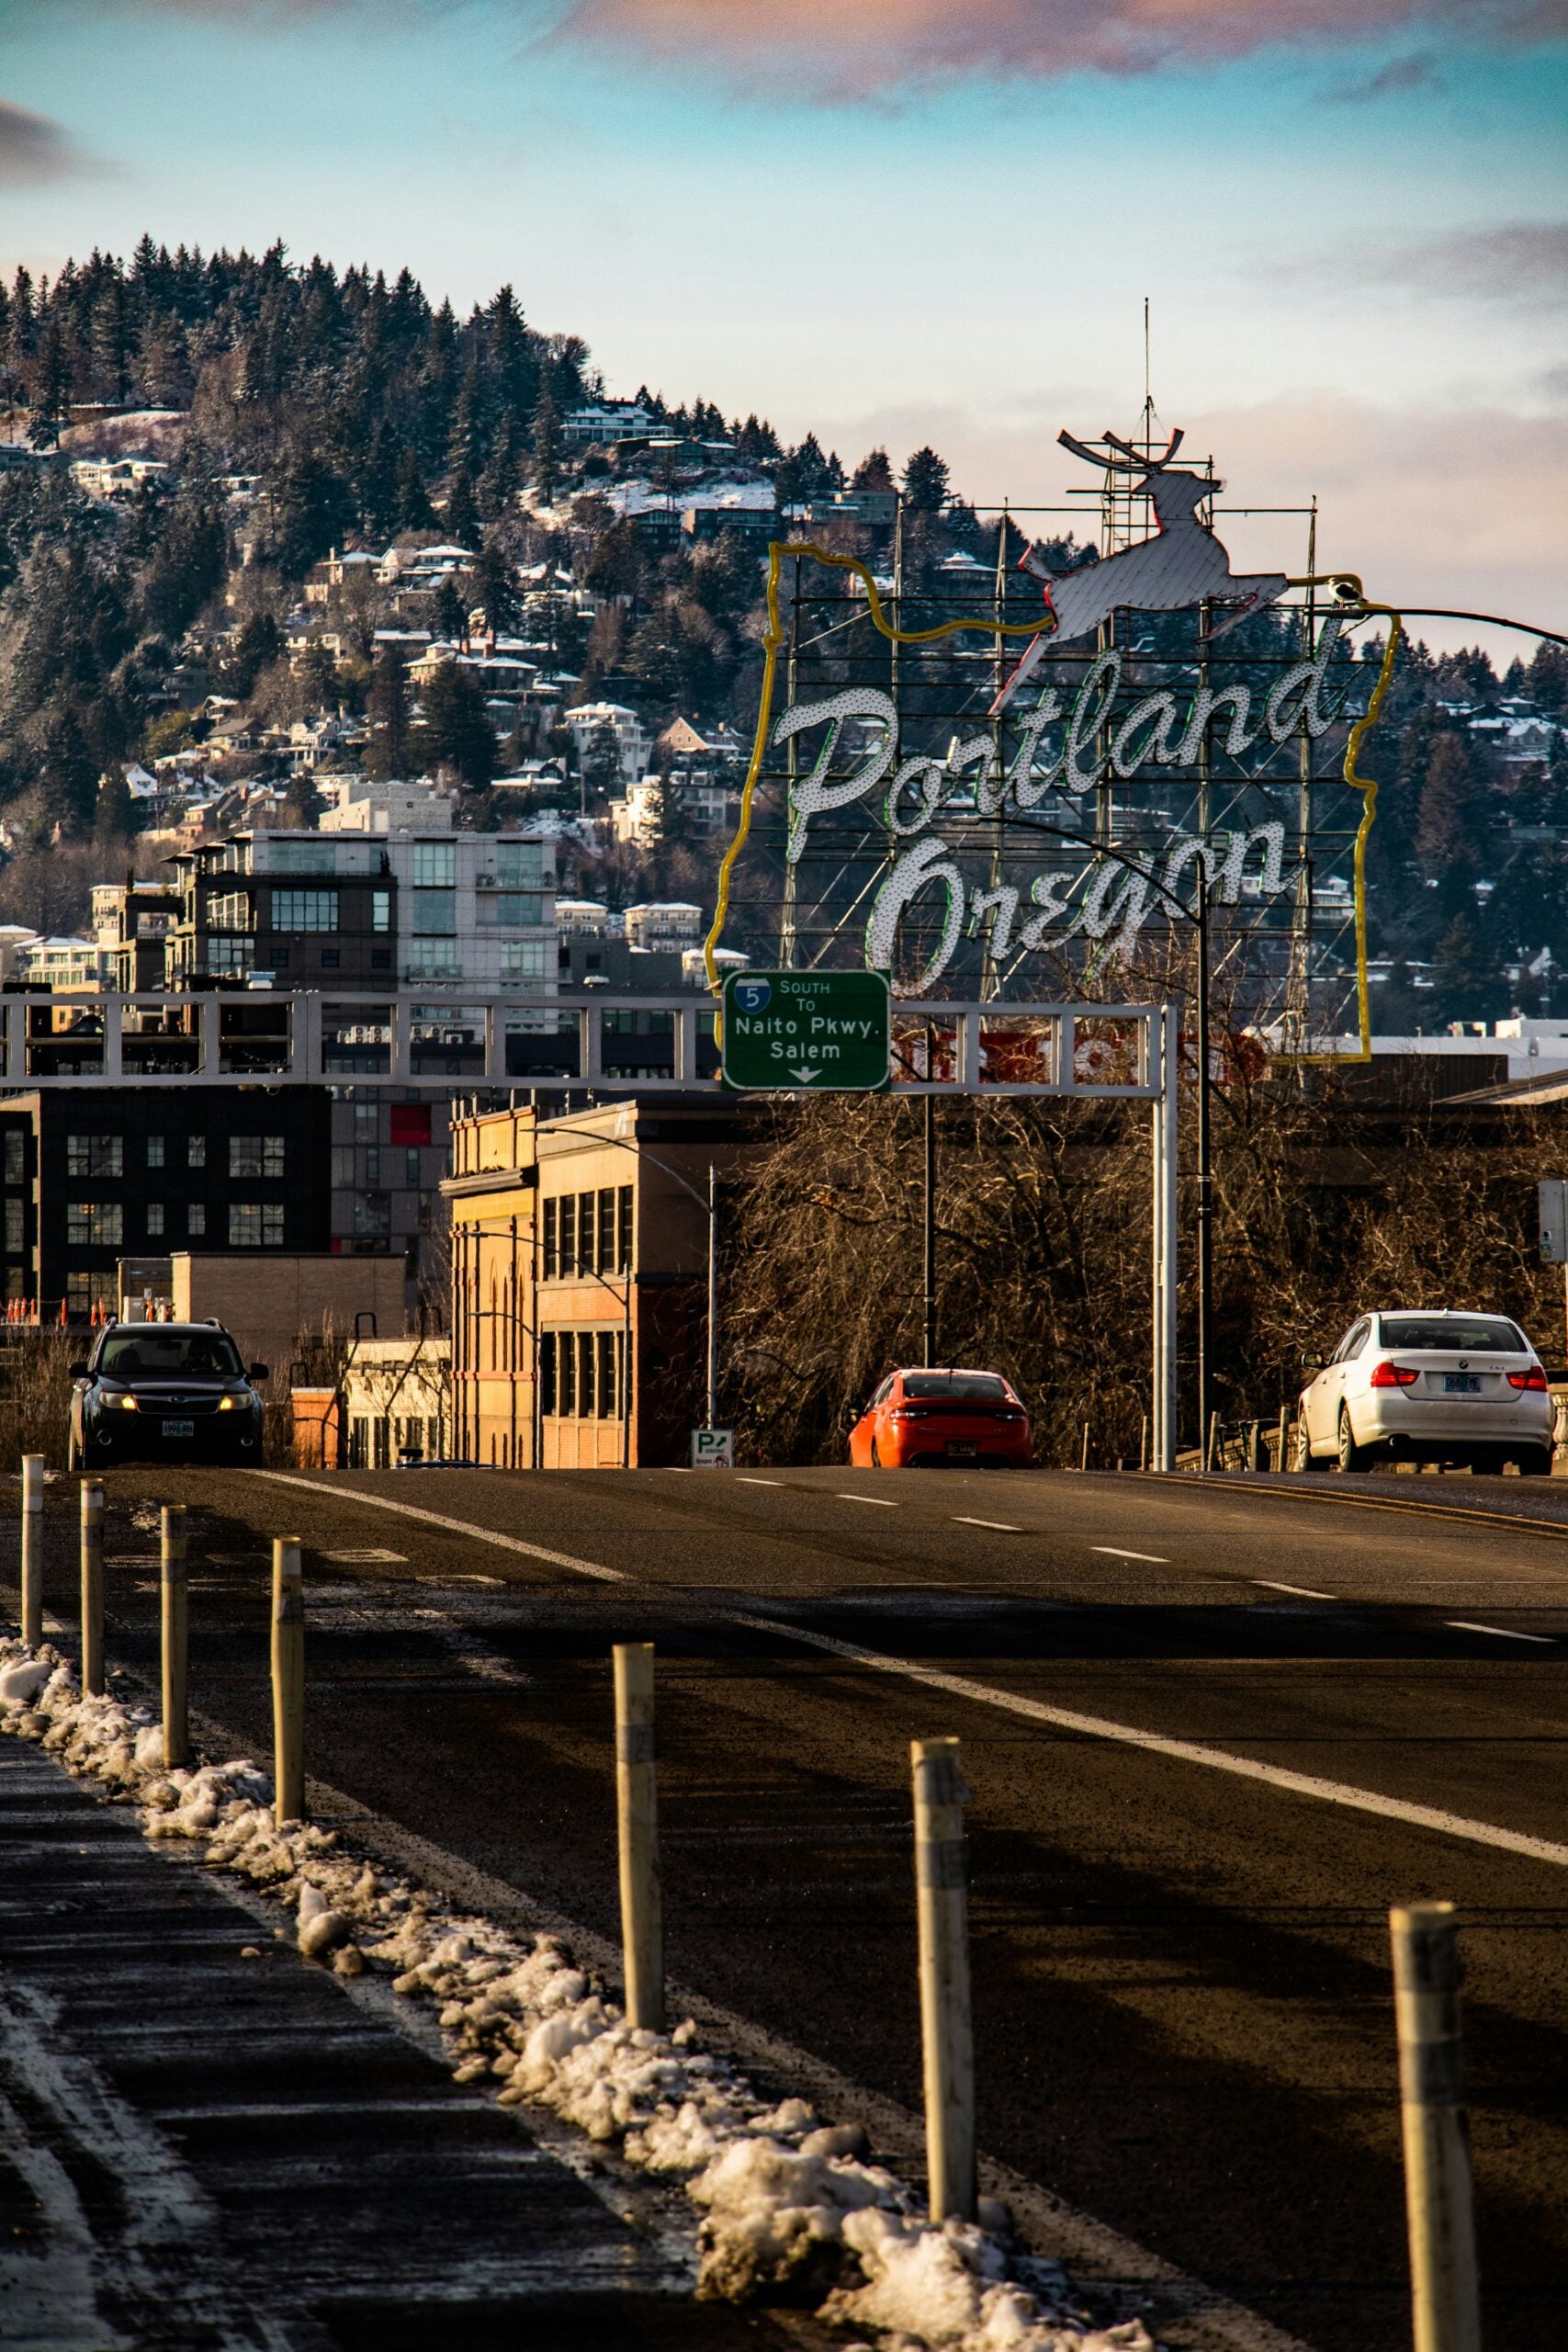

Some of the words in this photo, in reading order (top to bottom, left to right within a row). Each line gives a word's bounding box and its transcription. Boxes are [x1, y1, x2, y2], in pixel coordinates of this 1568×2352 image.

[772, 616, 1348, 864] Portland
[865, 820, 1303, 1000] Oregon
[780, 980, 830, 994] SOUTH
[746, 988, 760, 1008] 5
[736, 1017, 797, 1035] Naito
[811, 1017, 879, 1039] Pkwy.
[771, 1042, 840, 1058] Salem
